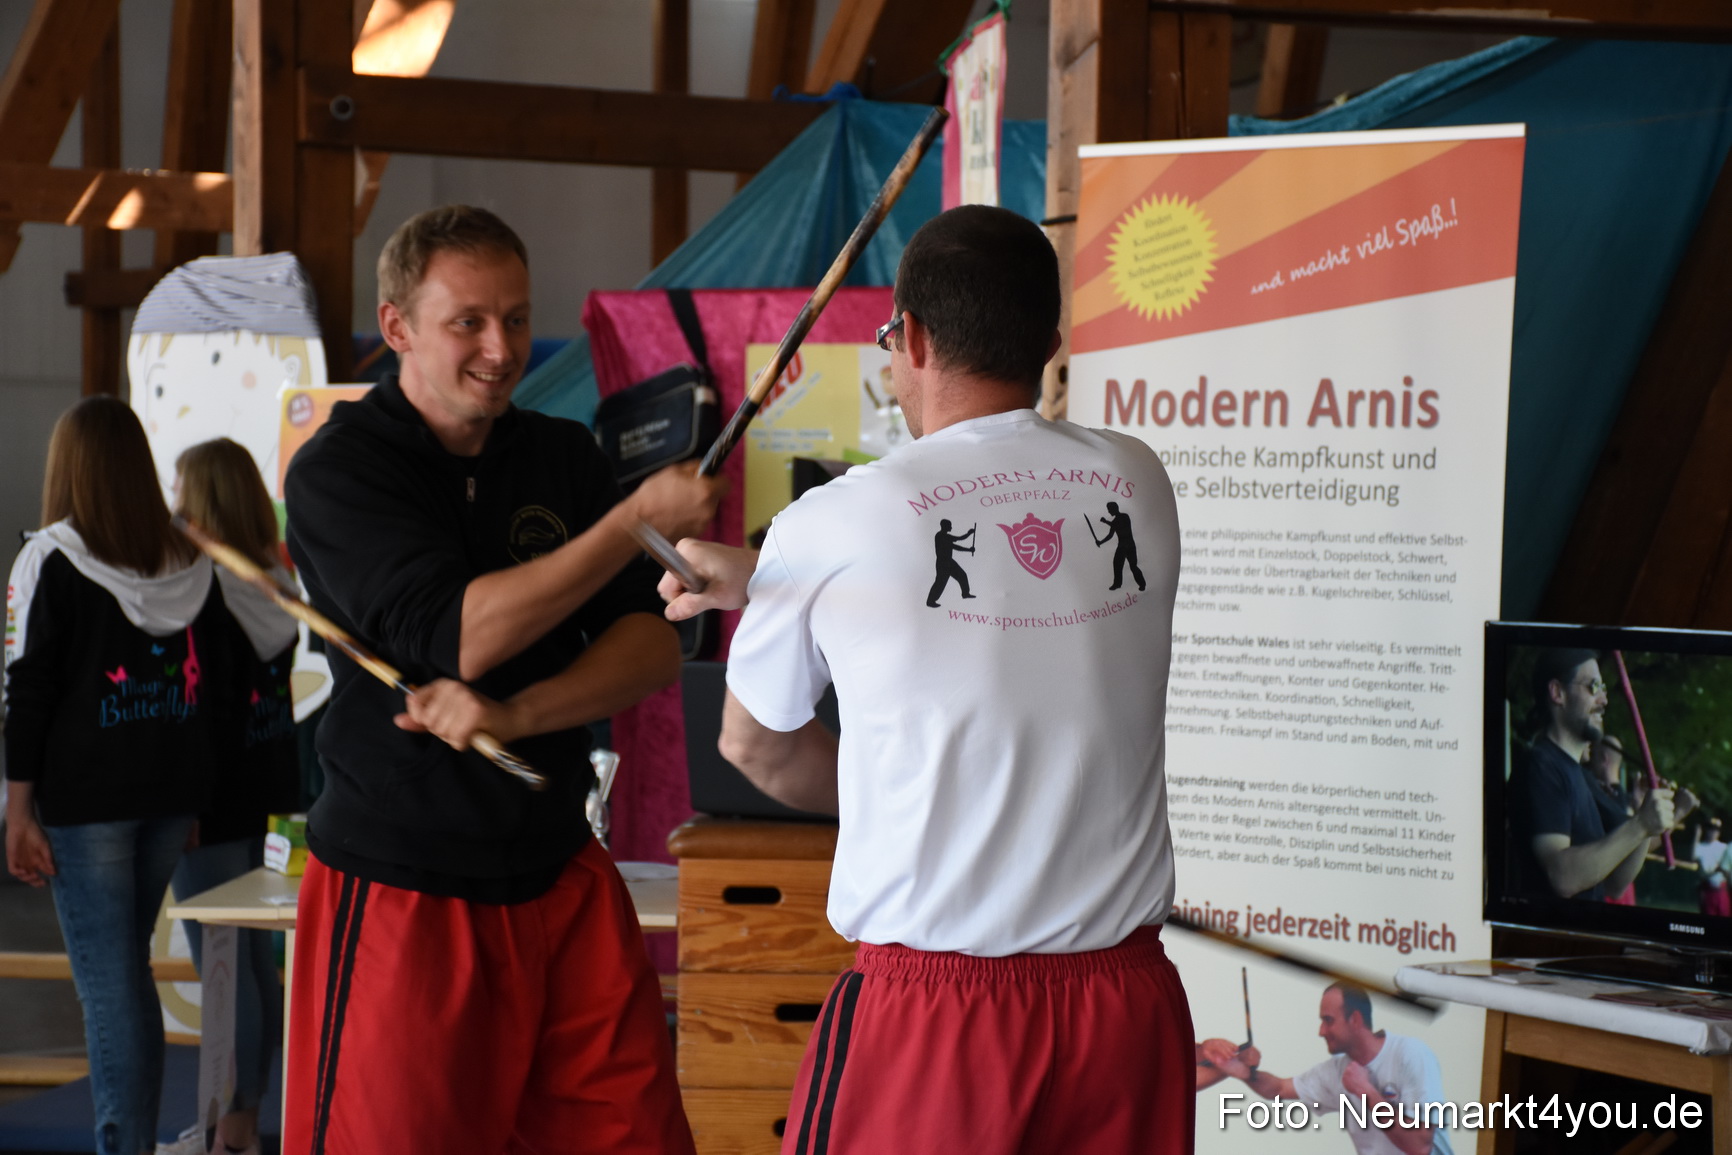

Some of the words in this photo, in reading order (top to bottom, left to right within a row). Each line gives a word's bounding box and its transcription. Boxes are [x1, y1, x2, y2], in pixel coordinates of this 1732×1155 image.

[1289, 244, 1351, 282] macht
[1356, 225, 1395, 260] viel
[1103, 375, 1289, 429] Modern
[1306, 375, 1441, 429] Arnis
[1155, 445, 1247, 470] pinische
[1254, 446, 1385, 474] Kampfkunst
[1392, 447, 1437, 470] und
[907, 469, 1037, 517] MODERN
[1046, 467, 1137, 499] ARNIS
[1195, 477, 1400, 507] Selbstverteidigung
[1185, 530, 1208, 539] eine
[1211, 529, 1283, 542] philippinische
[1286, 530, 1350, 543] Kampfkunst
[1354, 532, 1376, 544] und
[1378, 532, 1427, 545] effektive
[1430, 533, 1468, 546] Selbst-
[1181, 547, 1208, 557] iniert
[1211, 547, 1235, 558] wird
[1238, 548, 1255, 559] mit
[1258, 548, 1320, 562] Einzelstock,
[1323, 549, 1394, 564] Doppelstock,
[1398, 551, 1447, 566] Schwert,
[1180, 564, 1208, 575] enlos
[1211, 565, 1240, 576] sowie
[1244, 566, 1261, 576] der
[1264, 564, 1349, 581] Übertragbarkeit
[1353, 569, 1372, 580] der
[1375, 569, 1431, 583] Techniken
[1434, 571, 1457, 584] und
[1174, 600, 1216, 611] nschirm
[1219, 602, 1242, 612] usw.
[1267, 586, 1286, 597] wie
[1289, 585, 1308, 597] z.B.
[1311, 586, 1394, 602] Kugelschreiber,
[1398, 588, 1453, 604] Schlüssel,
[947, 592, 1138, 631] www.sportschule-wales.de
[1171, 632, 1188, 644] der
[1191, 633, 1254, 647] Sportschule
[1257, 636, 1290, 649] Wales
[1293, 638, 1305, 649] ist
[1309, 639, 1332, 650] sehr
[1336, 641, 1387, 656] vielseitig.
[1390, 642, 1402, 654] Es
[1405, 645, 1462, 657] vermittelt
[1177, 653, 1209, 665] gegen
[1212, 652, 1271, 667] bewaffnete
[1274, 656, 1295, 667] und
[1298, 657, 1375, 671] unbewaffnete
[1378, 660, 1426, 675] Angriffe.
[1430, 662, 1457, 675] Tritt-
[1169, 670, 1199, 681] niken.
[1202, 670, 1285, 686] Entwaffnungen,
[1288, 675, 1325, 687] Konter
[1328, 677, 1349, 689] und
[1352, 678, 1426, 693] Gegenkonter.
[1430, 682, 1450, 694] He-
[1170, 687, 1261, 702] Nerventechniken.
[1265, 691, 1339, 708] Koordination,
[1342, 695, 1415, 712] Schnelligkeit,
[1166, 704, 1232, 721] hrnehmung.
[1235, 707, 1391, 727] Selbstbehauptungstechniken
[1395, 718, 1417, 729] und
[1420, 719, 1444, 731] Auf-
[1165, 724, 1217, 735] vertrauen.
[1220, 724, 1272, 740] Freikampf
[1275, 729, 1289, 739] im
[1292, 729, 1324, 742] Stand
[1326, 732, 1347, 744] und
[1351, 735, 1368, 745] am
[1371, 734, 1410, 749] Boden,
[1413, 737, 1433, 748] mit
[1436, 738, 1459, 751] und
[1167, 773, 1246, 791] Jugendtraining
[1248, 780, 1288, 792] werden
[1291, 782, 1308, 794] die
[1311, 783, 1381, 800] körperlichen
[1383, 789, 1406, 801] und
[1409, 791, 1439, 803] tech-
[1191, 793, 1210, 805] des
[1213, 795, 1255, 808] Modern
[1258, 798, 1285, 811] Arnis
[1288, 799, 1359, 817] altersgerecht
[1363, 808, 1421, 821] vermittelt.
[1425, 811, 1446, 823] Un-
[1200, 812, 1209, 822] in
[1211, 812, 1229, 824] der
[1232, 814, 1261, 829] Regel
[1264, 817, 1313, 831] zwischen
[1316, 820, 1324, 832] 6
[1326, 822, 1348, 834] und
[1350, 825, 1398, 838] maximal
[1402, 828, 1414, 840] 11
[1418, 829, 1456, 843] Kinder
[1178, 828, 1210, 841] Werte
[1213, 831, 1232, 842] wie
[1234, 832, 1286, 848] Kontrolle,
[1289, 836, 1335, 852] Disziplin
[1338, 841, 1360, 853] und
[1362, 842, 1453, 862] Selbstsicherheit
[1173, 845, 1214, 860] fördert,
[1217, 849, 1241, 861] aber
[1243, 852, 1270, 864] auch
[1272, 853, 1291, 866] der
[1293, 855, 1321, 871] Spaß
[1324, 858, 1363, 873] kommt
[1365, 862, 1383, 875] bei
[1386, 865, 1406, 877] uns
[1409, 866, 1437, 880] nicht
[1441, 870, 1455, 881] zu
[1171, 898, 1239, 938] aining
[1243, 904, 1351, 943] jederzeit
[1357, 918, 1457, 954] möglich
[1669, 922, 1706, 936] SAMSUNG
